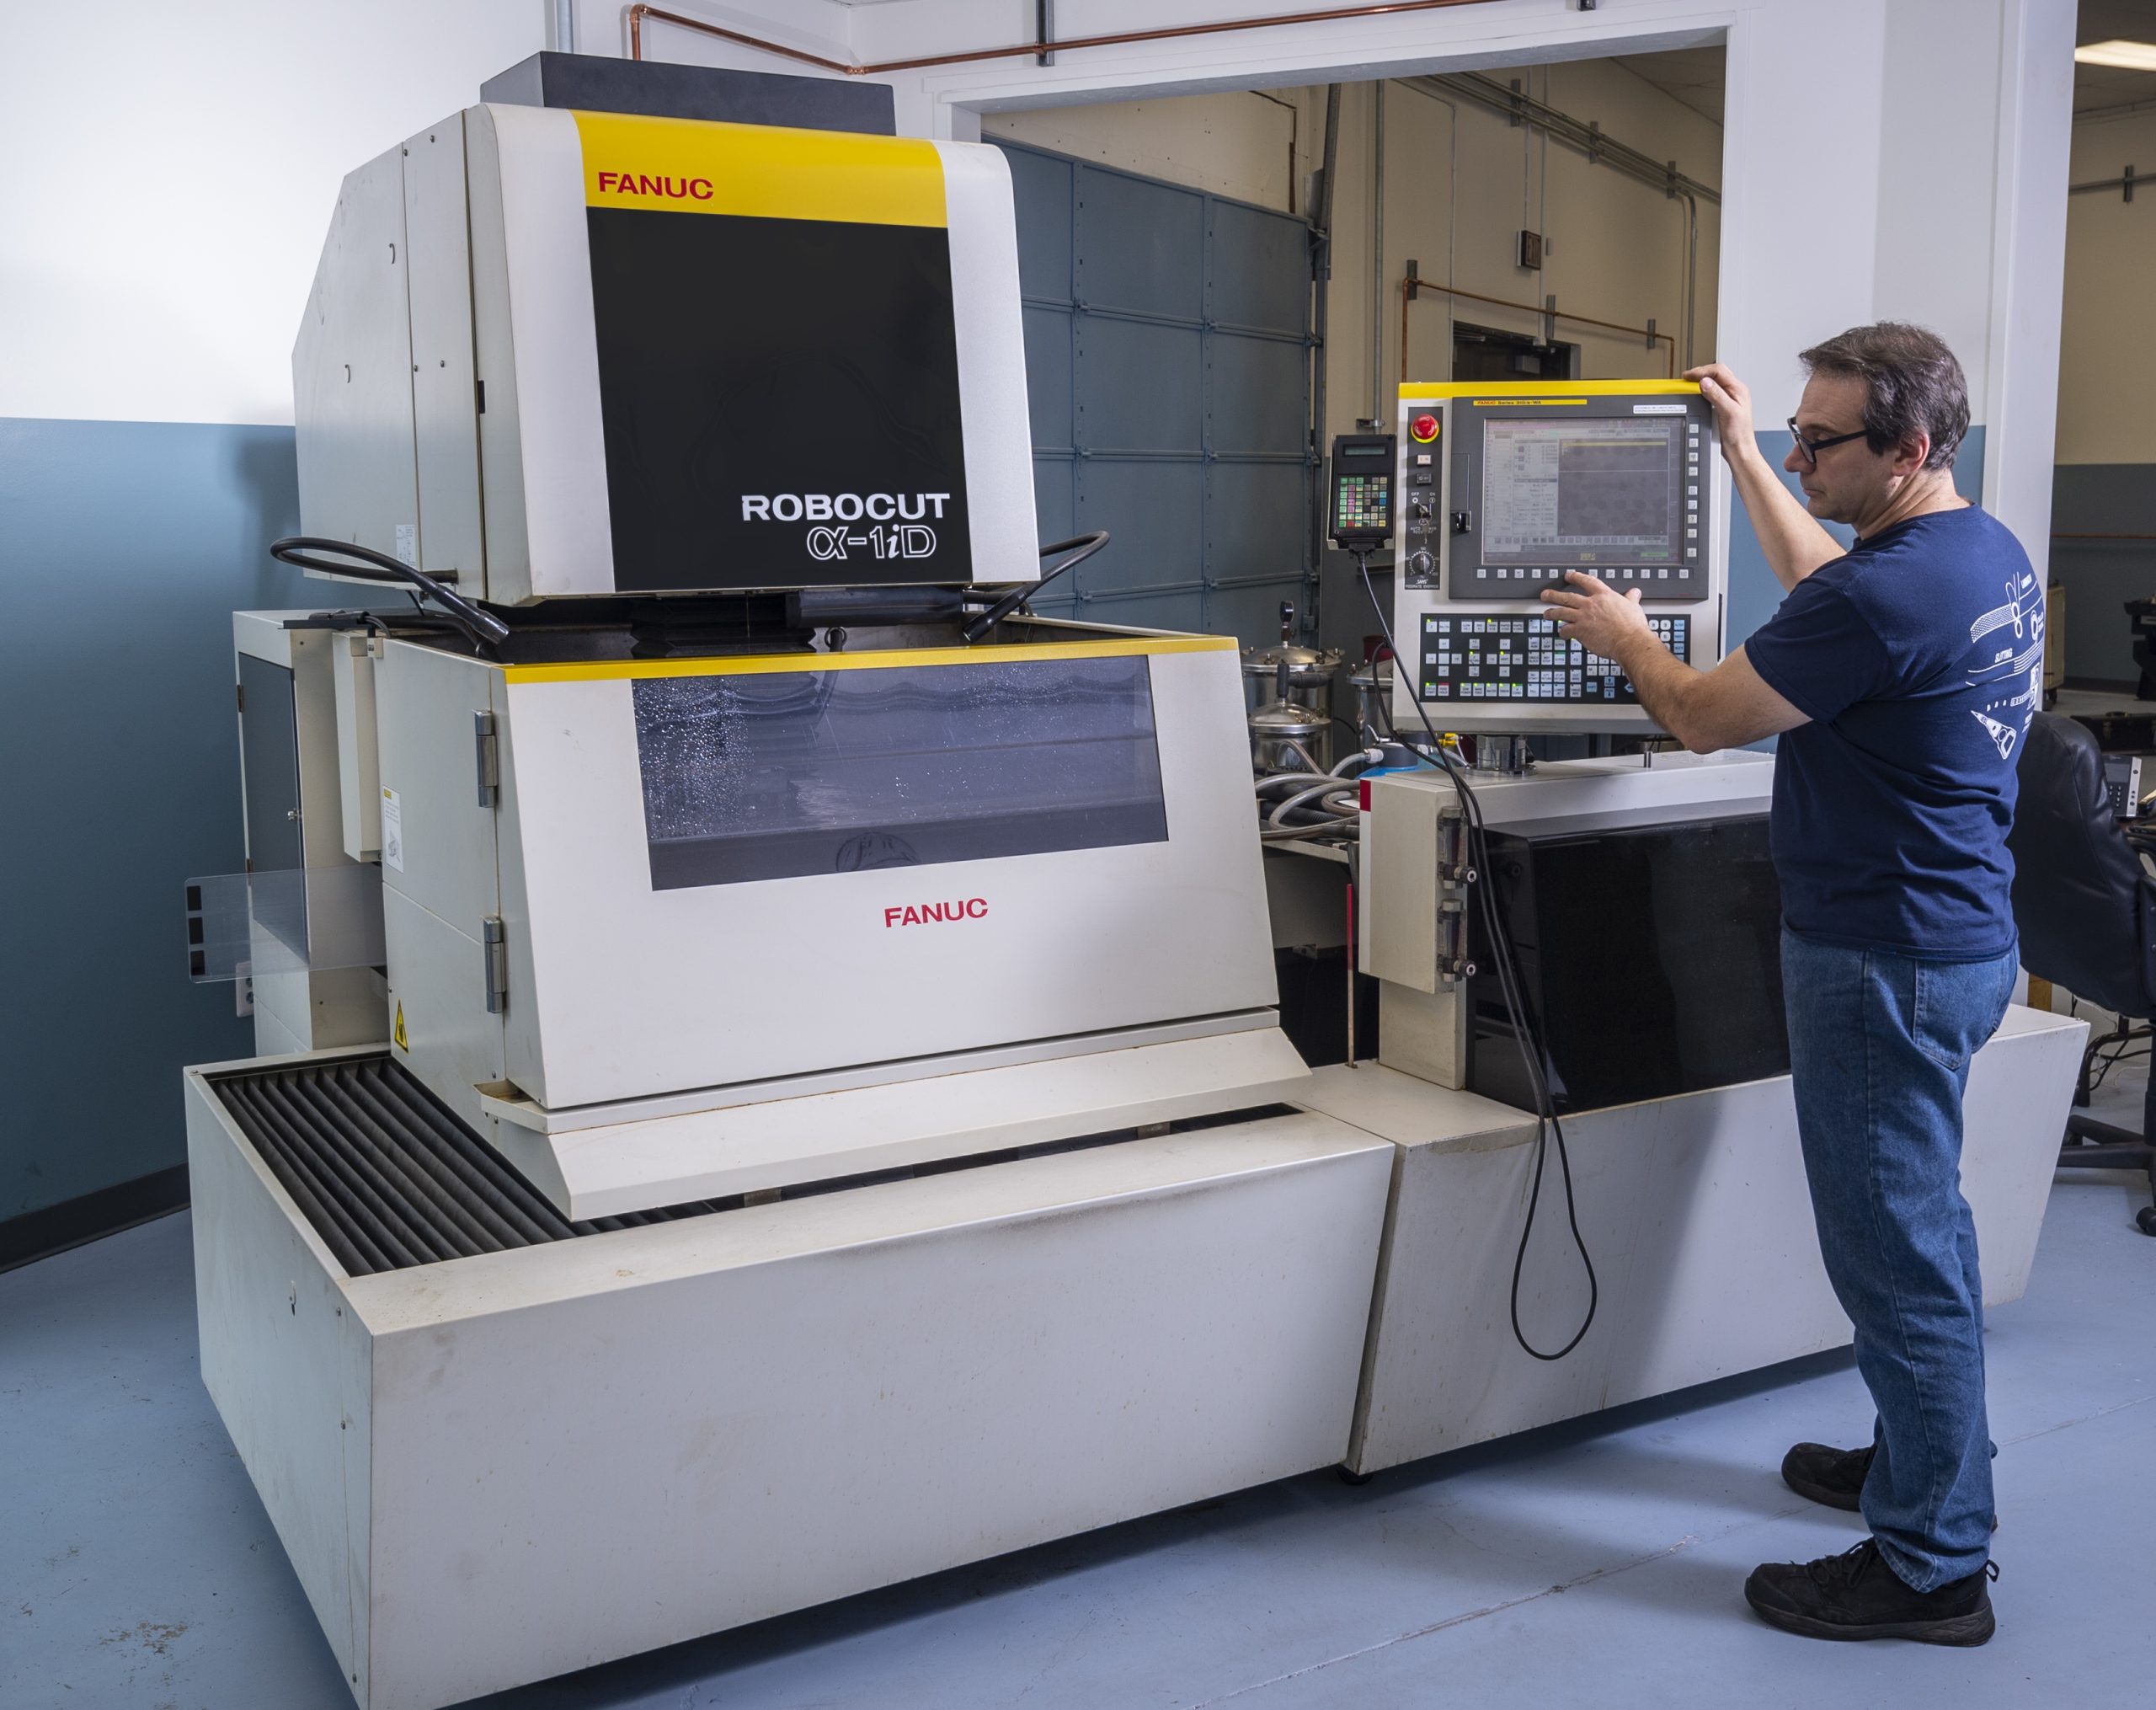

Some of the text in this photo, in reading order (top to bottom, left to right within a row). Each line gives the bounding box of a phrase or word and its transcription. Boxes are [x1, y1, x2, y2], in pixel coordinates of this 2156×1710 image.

[598, 172, 714, 200] FANUC
[741, 493, 951, 521] ROBOCUT
[884, 898, 988, 928] FANUC
